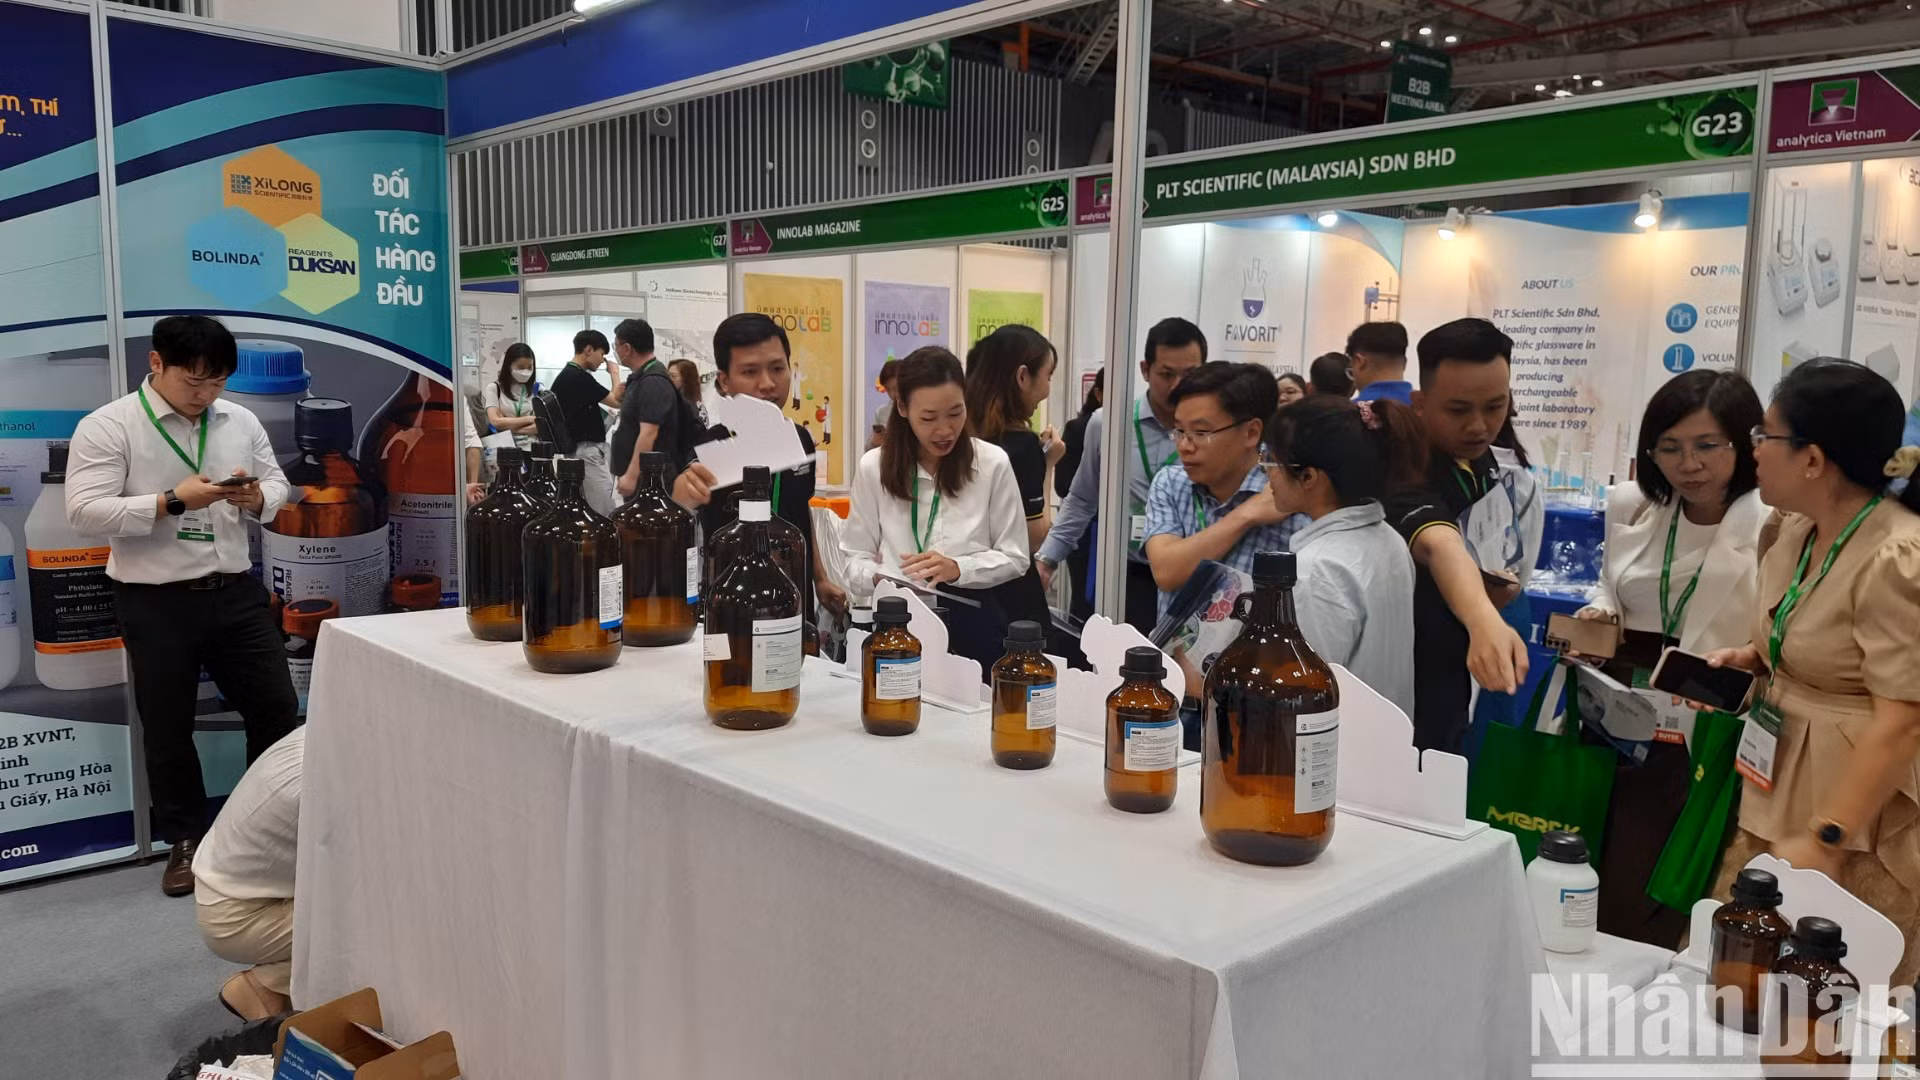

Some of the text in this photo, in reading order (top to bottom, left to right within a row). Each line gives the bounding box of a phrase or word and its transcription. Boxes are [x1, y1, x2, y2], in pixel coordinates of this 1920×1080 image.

[1409, 77, 1431, 95] B2B
[29, 97, 58, 116] THÍ
[1691, 110, 1743, 138] G23
[1775, 127, 1887, 148] analytica Vietnam
[1156, 147, 1457, 200] PLT SCIENTIFIC (MALAYSIA) SDN BHD
[372, 168, 410, 199] ĐỐI
[1040, 196, 1065, 213] G25
[374, 207, 420, 236] TÁC
[777, 219, 861, 240] INNOLAB MAGAZINE
[713, 234, 727, 246] G27
[191, 249, 260, 266] BOLINDA
[288, 248, 333, 258] REAGENTS
[550, 246, 609, 263] GUANGDONG JETKEEN
[288, 256, 356, 275] DUKSAN
[1690, 265, 1717, 276] OUR
[376, 275, 424, 306] ĐẦU
[1521, 279, 1574, 289] ABOUT US
[1493, 308, 1509, 319] PLT
[1511, 307, 1555, 318] Scientific
[1556, 307, 1575, 318] Sdn
[1502, 324, 1596, 337] leading company in
[1535, 341, 1583, 352] glassware
[1585, 341, 1596, 350] in
[1543, 356, 1562, 366] has
[1564, 356, 1588, 366] been
[1516, 370, 1564, 384] producing
[1542, 402, 1595, 416] laboratory
[1532, 418, 1557, 428] since
[1560, 419, 1587, 429] 1989
[400, 500, 453, 509] Acetonitrile
[298, 544, 337, 555] Xylene
[42, 555, 86, 564] BOLINDA
[414, 559, 429, 567] 2.5
[23, 727, 76, 747] XVNT,
[24, 769, 75, 786] Trung
[80, 763, 112, 777] Hòa
[10, 780, 112, 807] Giấy, Hà Nội
